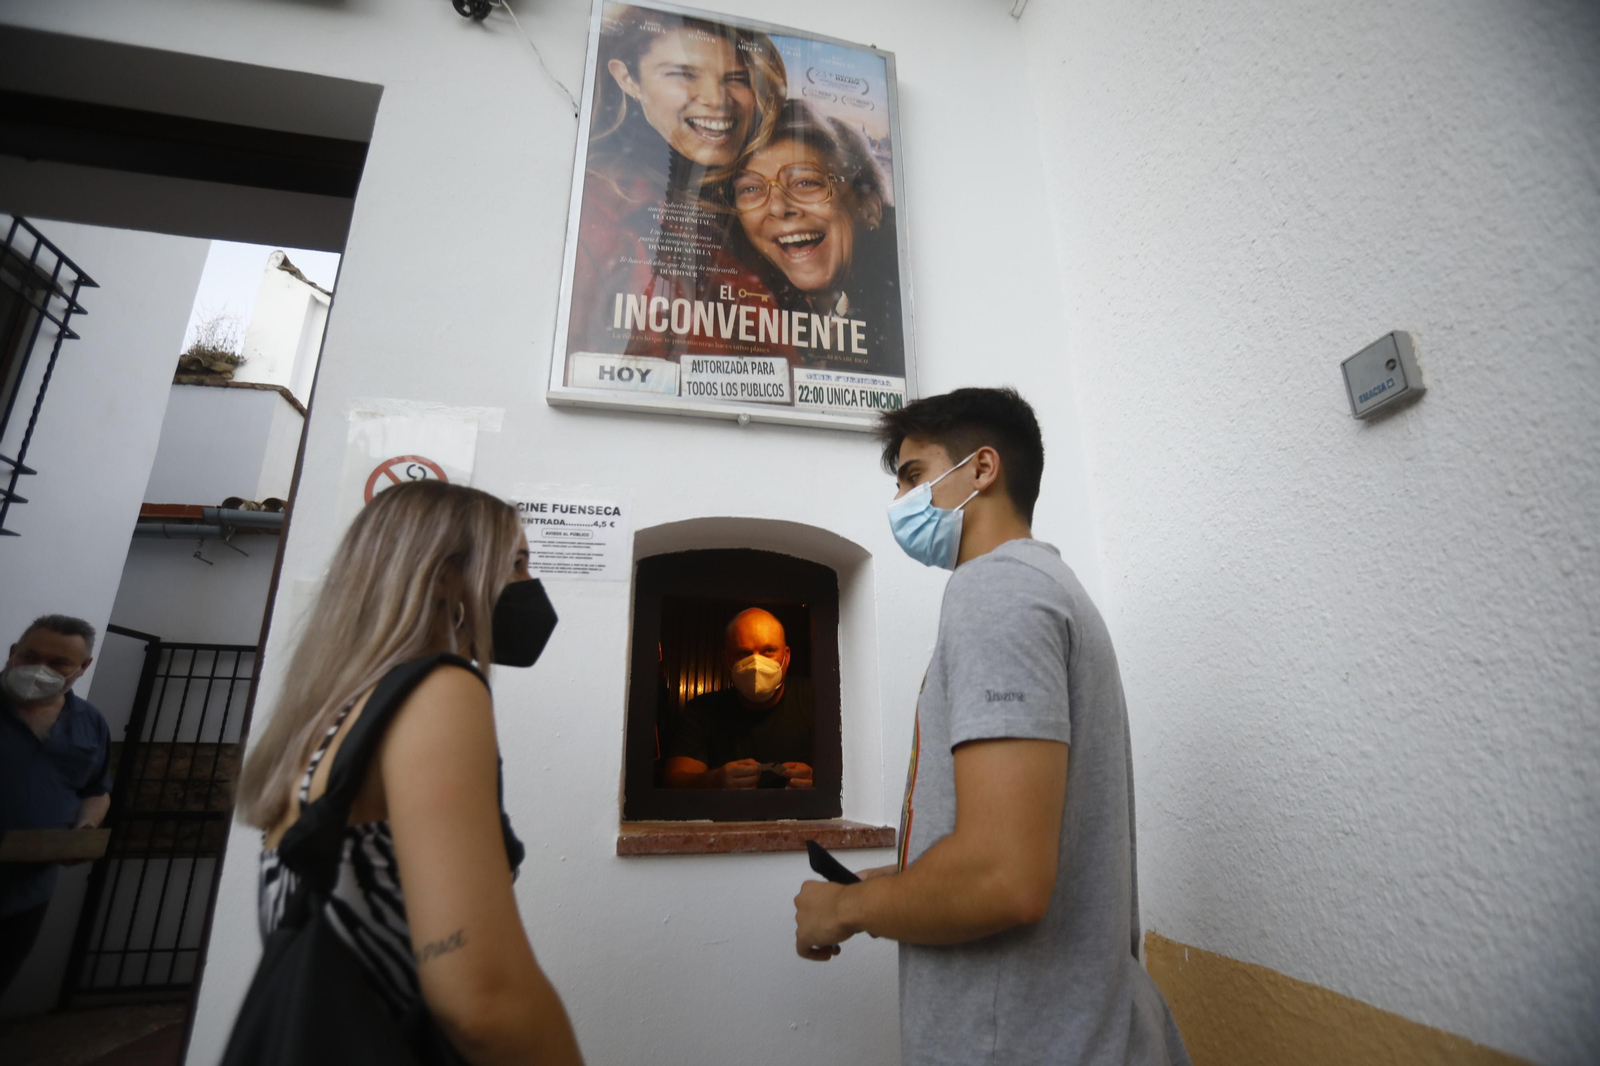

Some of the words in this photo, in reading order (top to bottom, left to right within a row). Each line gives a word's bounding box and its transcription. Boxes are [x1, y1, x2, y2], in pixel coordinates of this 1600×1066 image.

[662, 215, 710, 225] CONFIDENCIAL
[665, 238, 688, 246] tiempos
[680, 262, 697, 270] llevas
[706, 266, 738, 274] mascarilla
[720, 285, 735, 301] EL
[613, 293, 867, 354] INCONVENIENTE
[687, 339, 714, 348] mientras
[716, 341, 732, 349] haces
[750, 345, 769, 353] planes
[599, 365, 652, 383] HOY
[692, 359, 748, 376] AUTORIZADA
[751, 362, 775, 375] PARA
[687, 381, 717, 397] TODOS
[721, 383, 738, 397] LOS
[741, 383, 784, 398] PUBLICOS
[798, 385, 824, 403] 22:00
[827, 387, 858, 406] UNICA
[860, 390, 903, 410] FUNCION
[1359, 383, 1387, 403] EMACSA
[517, 502, 548, 512] CINE
[552, 504, 621, 516] FUENSECA
